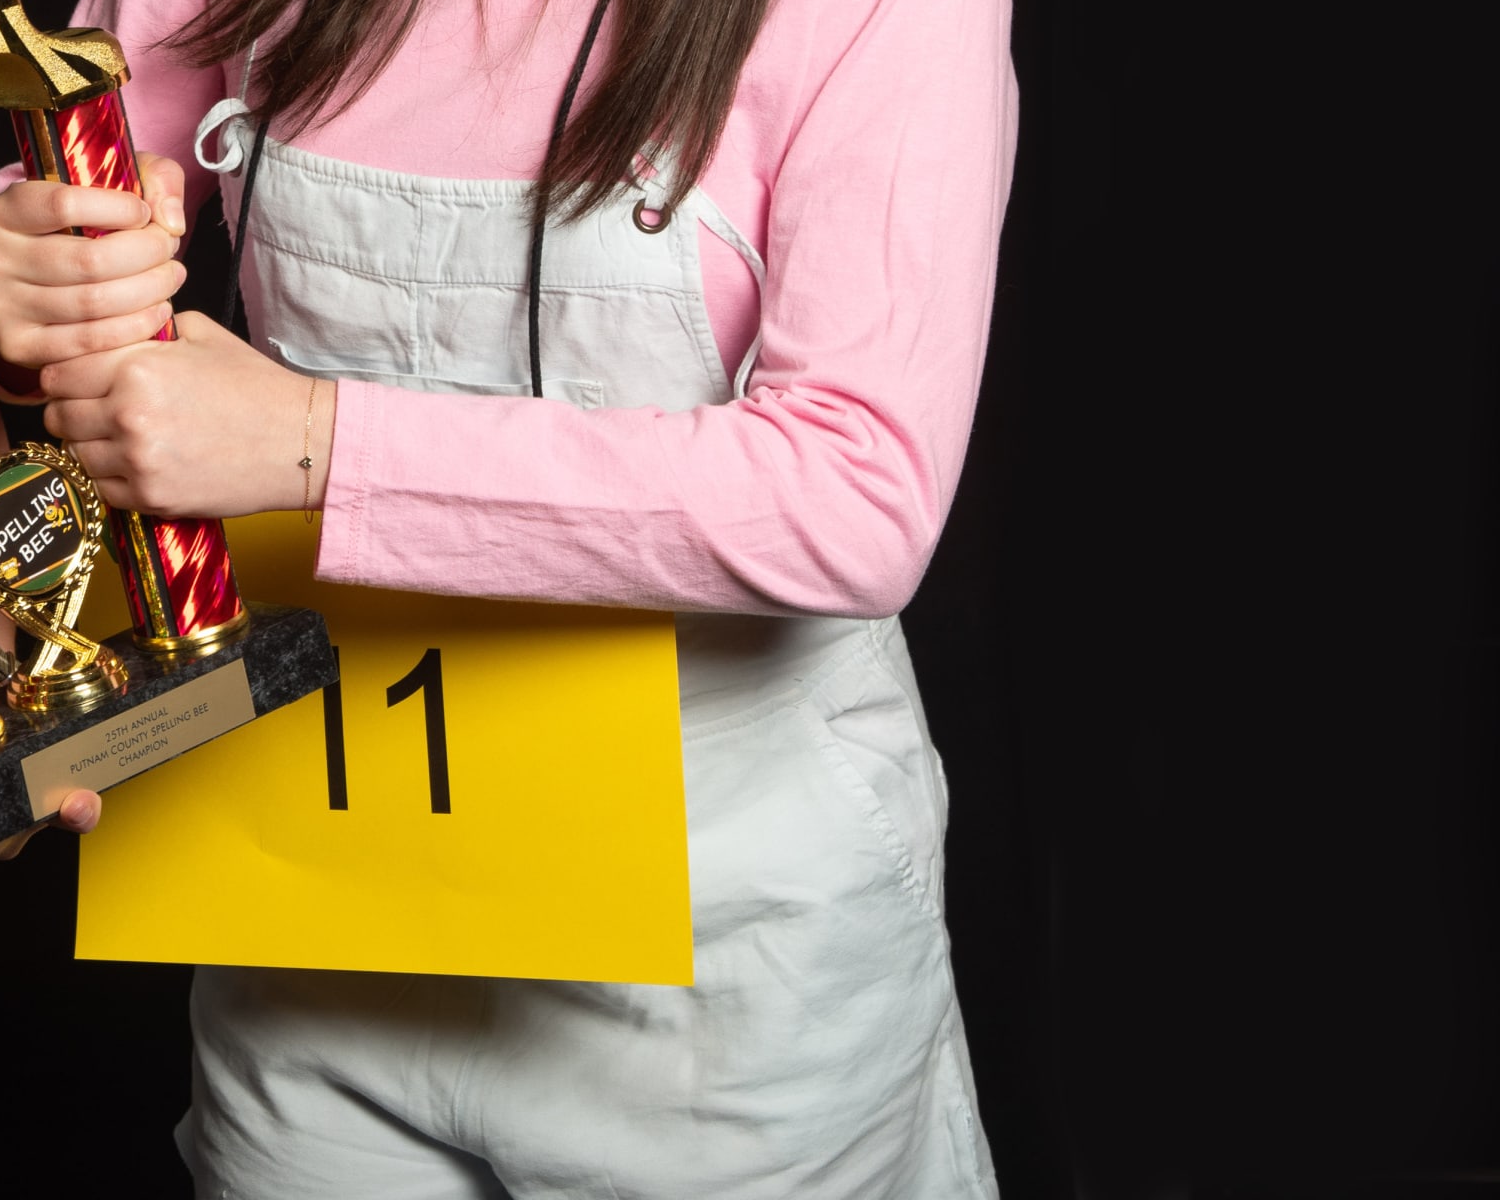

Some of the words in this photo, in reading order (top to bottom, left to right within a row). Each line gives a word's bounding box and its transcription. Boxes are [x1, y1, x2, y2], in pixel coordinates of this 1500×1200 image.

[18, 529, 55, 564] BEE
[69, 750, 109, 774] PUTNAM
[110, 731, 148, 755] COUNTY
[151, 711, 191, 737] SPELLING
[192, 702, 210, 718] BEE
[104, 726, 129, 743] 25TH
[131, 707, 169, 730] ANNUAL
[323, 645, 452, 815] 11
[118, 738, 169, 767] CHAMPION
